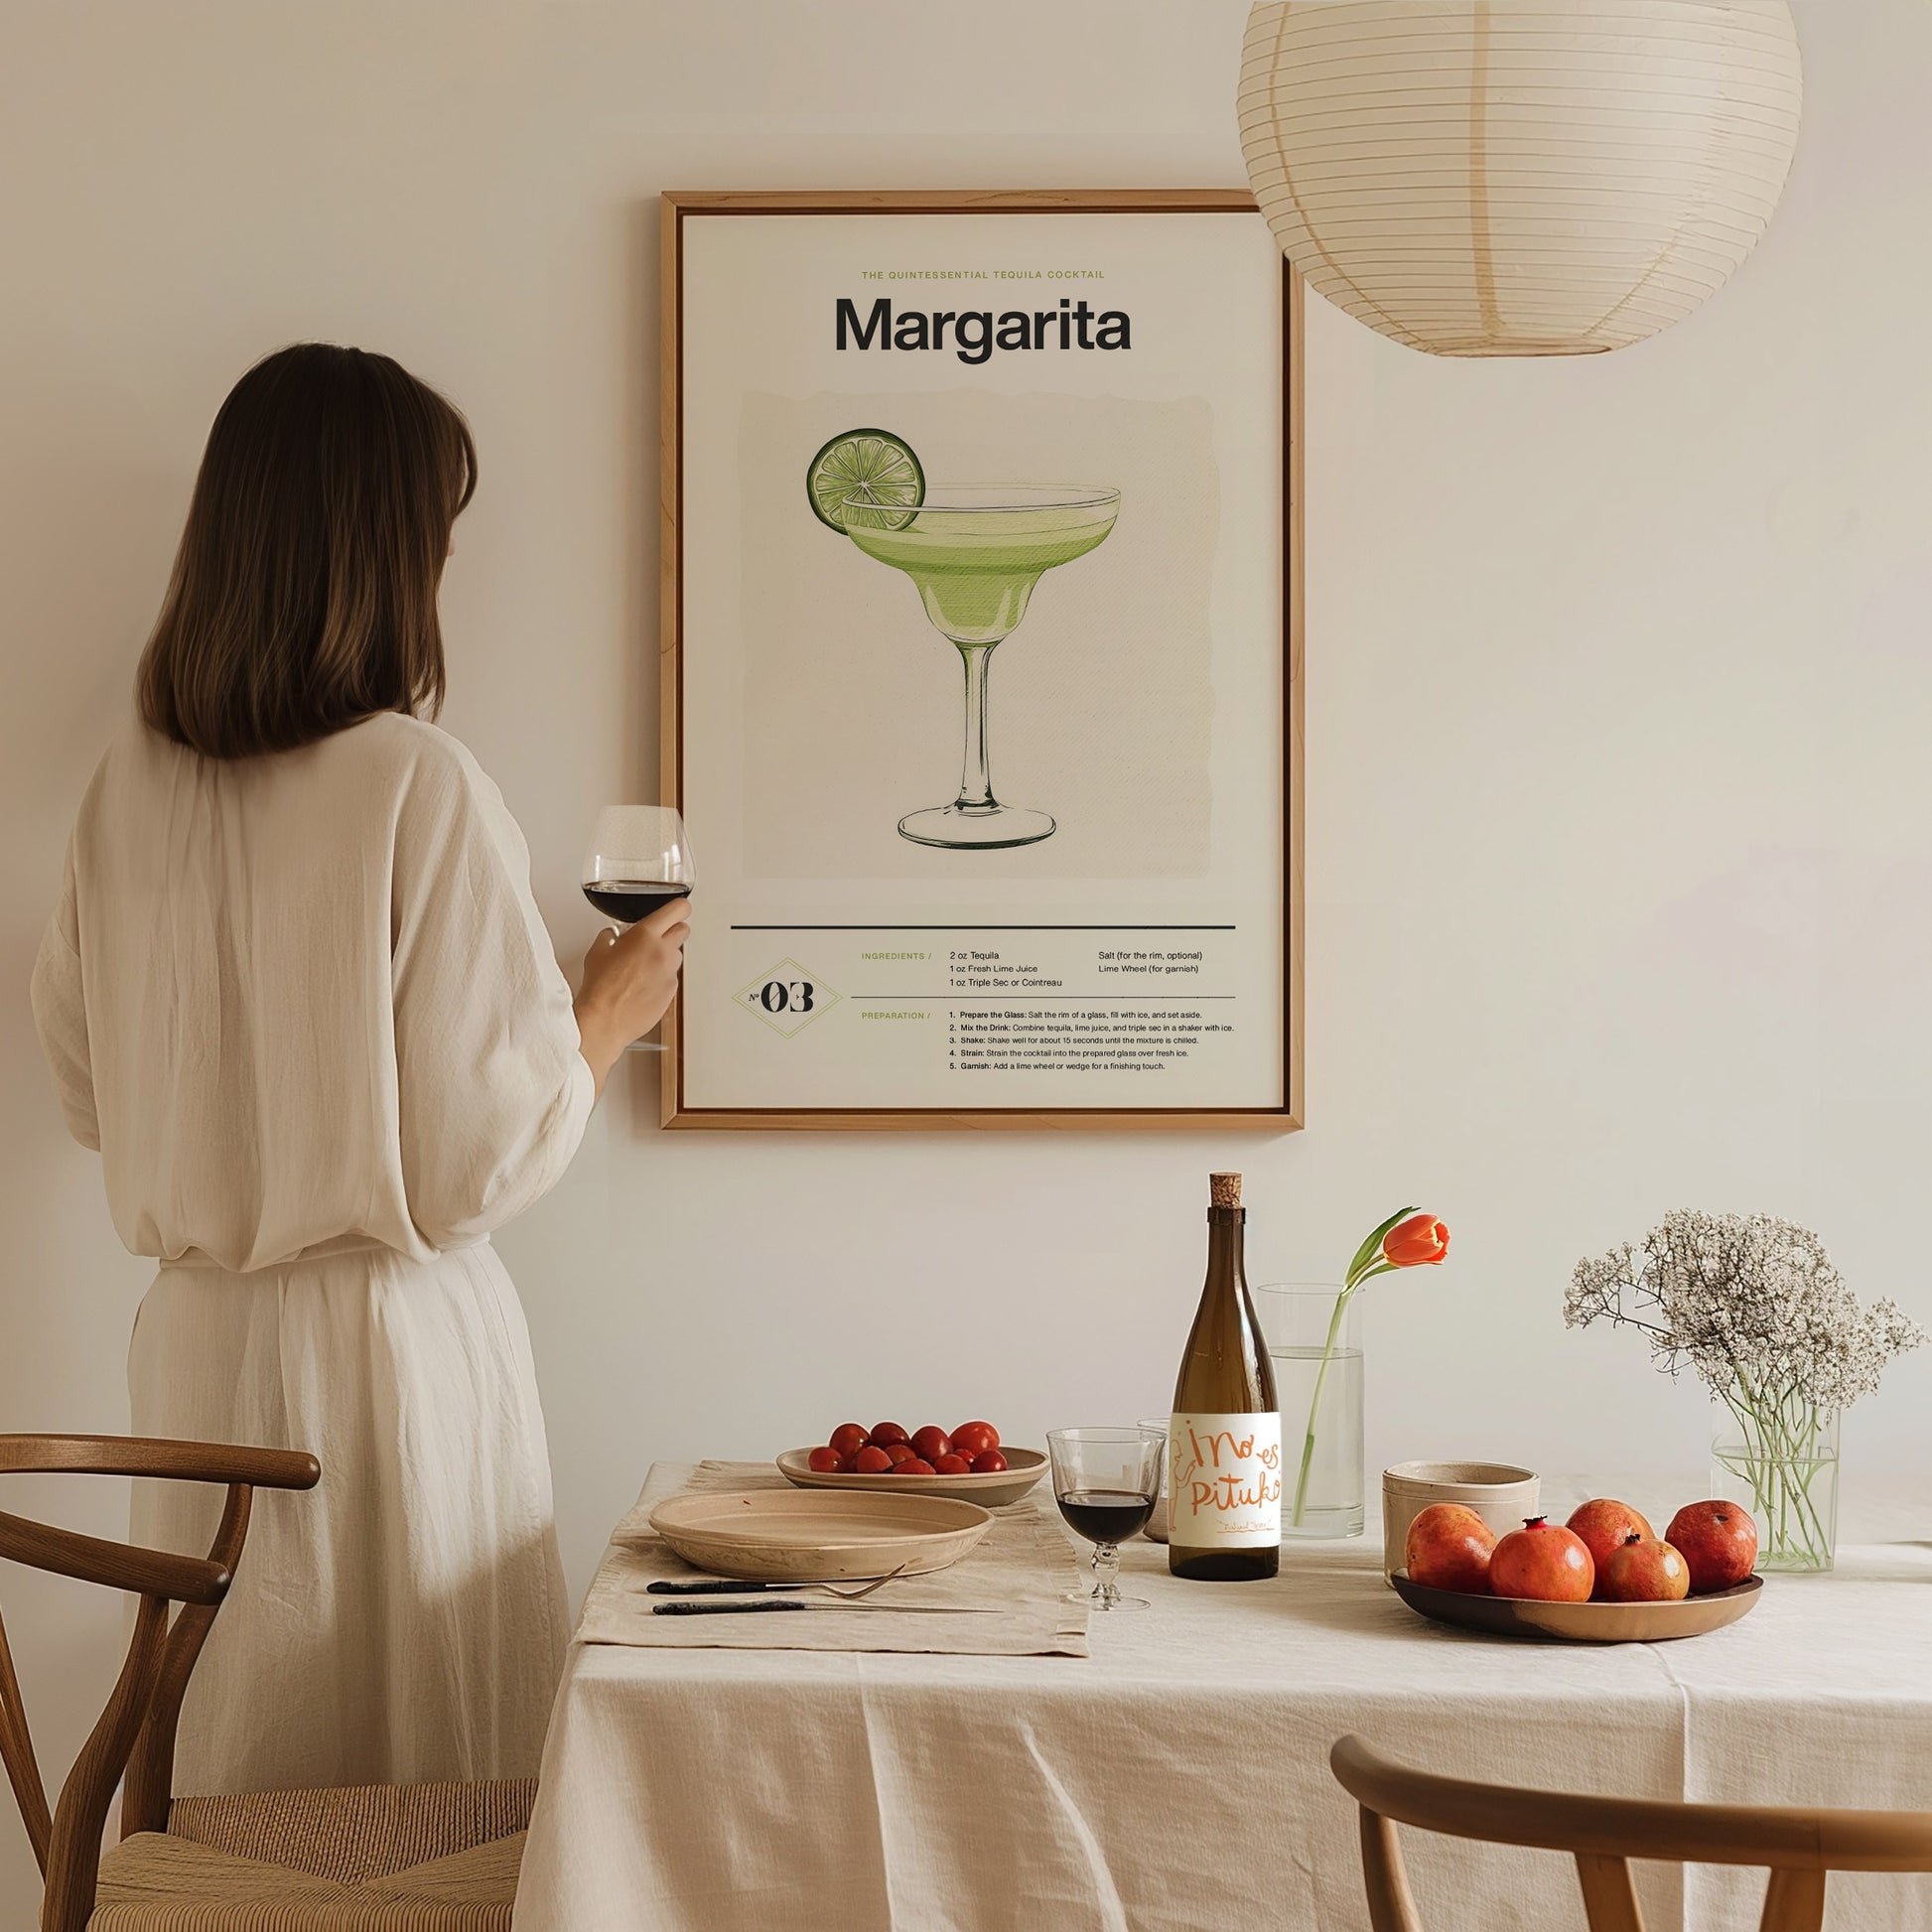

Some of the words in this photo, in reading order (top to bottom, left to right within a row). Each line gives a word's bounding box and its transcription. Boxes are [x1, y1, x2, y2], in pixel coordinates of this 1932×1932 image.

[861, 271, 884, 280] THE
[888, 270, 988, 280] QUINTESSENTIAL
[993, 270, 1042, 279] TEQUILA
[1047, 270, 1105, 279] COCKTAIL
[836, 298, 1132, 365] Margarita
[861, 952, 925, 961] INGREDIENTS
[970, 951, 1000, 961] Tequila
[1098, 951, 1115, 960] Salt
[1116, 951, 1132, 961] (for
[1133, 951, 1147, 960] the
[1149, 951, 1165, 961] rim,
[1166, 951, 1203, 961] optional)
[968, 964, 992, 973] Fresh
[993, 965, 1014, 973] Lime
[1015, 965, 1038, 973] Juice
[1098, 965, 1119, 973] Lime
[1121, 965, 1147, 973] Wheel
[1148, 964, 1164, 974] (for
[1165, 964, 1199, 975] garnish)
[968, 978, 991, 988] Triple
[992, 978, 1009, 987] Sec
[1021, 978, 1062, 987] Cointreau
[760, 981, 814, 1013] 03
[861, 1012, 925, 1020] PREPARATION
[959, 1011, 989, 1020] Prepare
[1004, 1011, 1027, 1019] Glass:
[1028, 1011, 1043, 1019] Salt
[1087, 1011, 1109, 1020] glass,
[1137, 1011, 1150, 1019] ice,
[949, 1023, 957, 1032] 2.
[989, 1024, 1011, 1032] Drink:
[1012, 1024, 1045, 1032] Combine
[1047, 1024, 1074, 1033] tequila,
[1091, 1024, 1111, 1033] juice,
[1128, 1024, 1147, 1033] triple
[1178, 1024, 1203, 1032] shaker
[960, 1049, 985, 1057] Strain:
[986, 1049, 1008, 1057] Strain
[1082, 1049, 1116, 1058] prepared
[1116, 1050, 1137, 1059] glass
[960, 1062, 992, 1070] Garnish:
[1065, 1063, 1091, 1072] wedge
[1110, 1062, 1141, 1072] finishing
[1256, 1444, 1279, 1469] es
